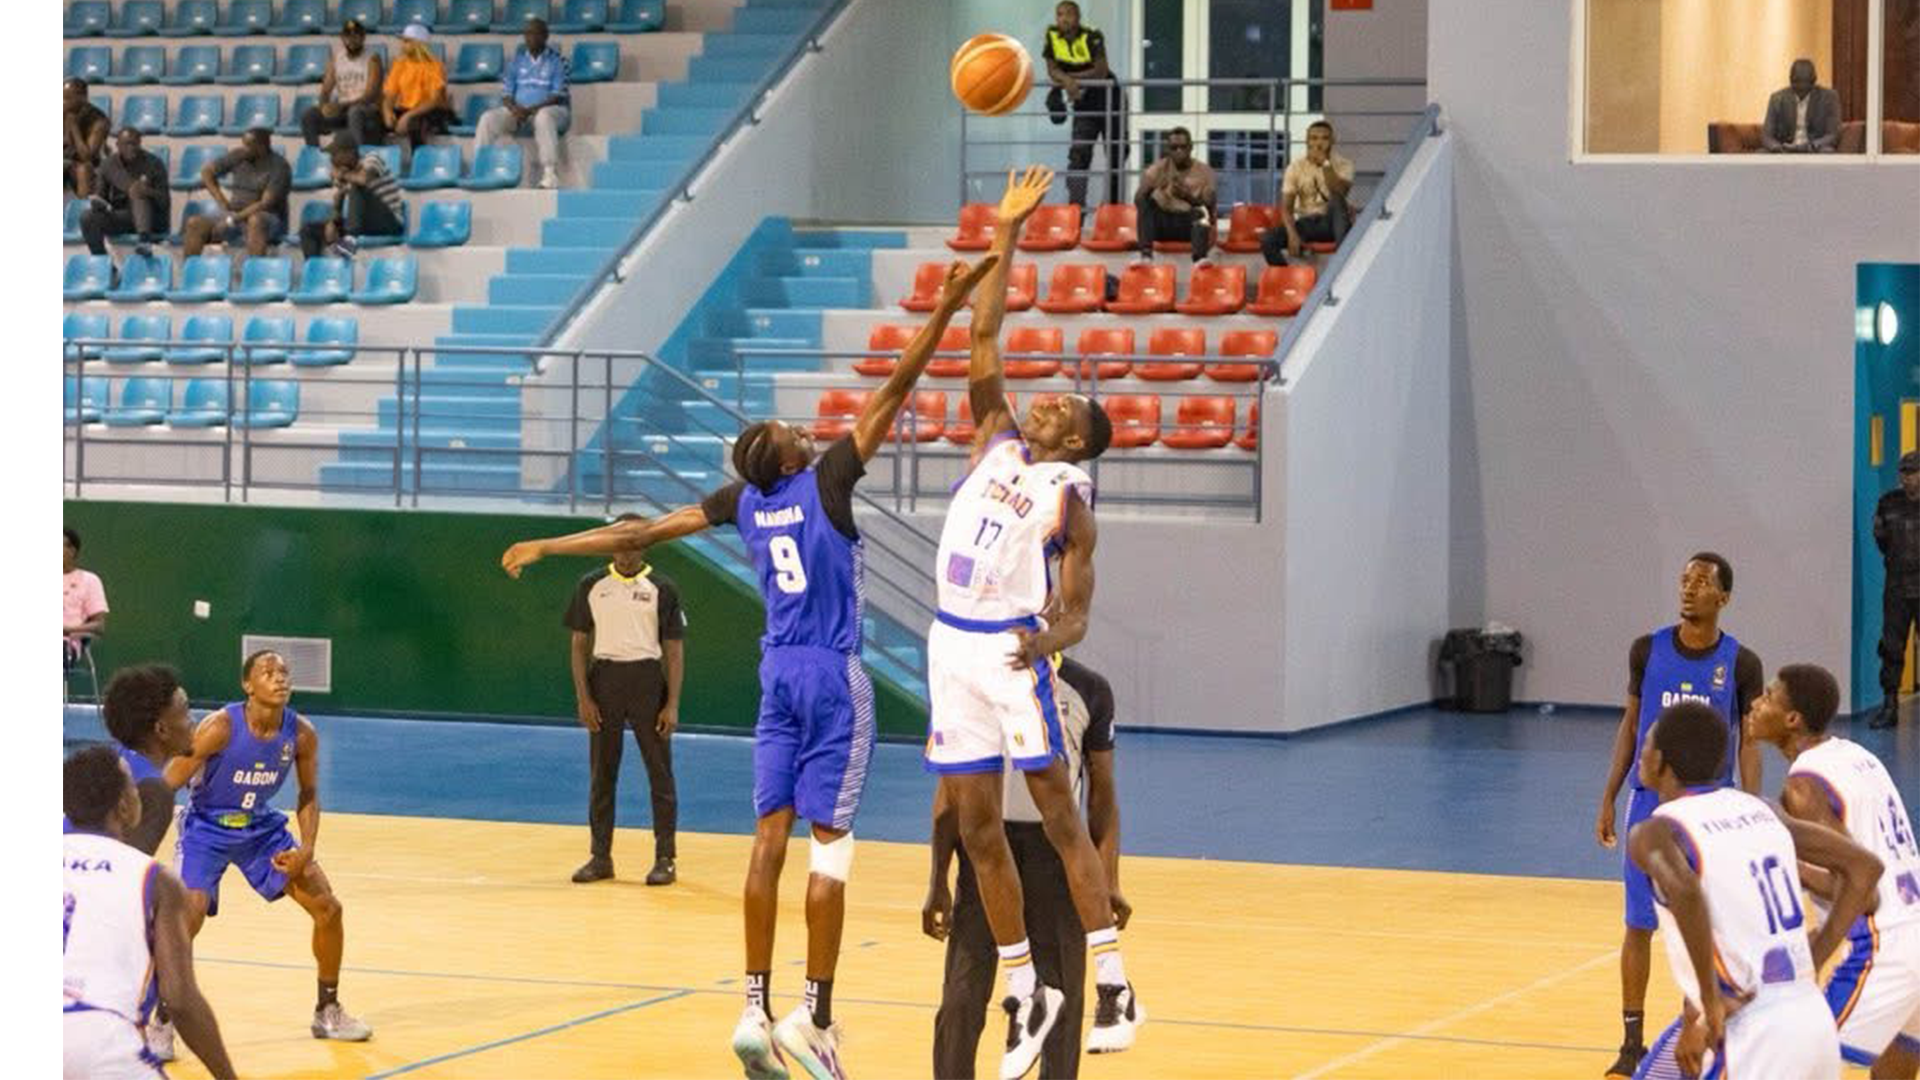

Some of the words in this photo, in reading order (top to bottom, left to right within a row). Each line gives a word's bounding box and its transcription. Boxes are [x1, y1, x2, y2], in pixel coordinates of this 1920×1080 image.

[974, 517, 1002, 549] 17
[769, 535, 807, 594] 9
[233, 769, 278, 785] GABON
[241, 792, 256, 809] 8
[63, 858, 112, 872] KA
[1750, 856, 1803, 934] 10
